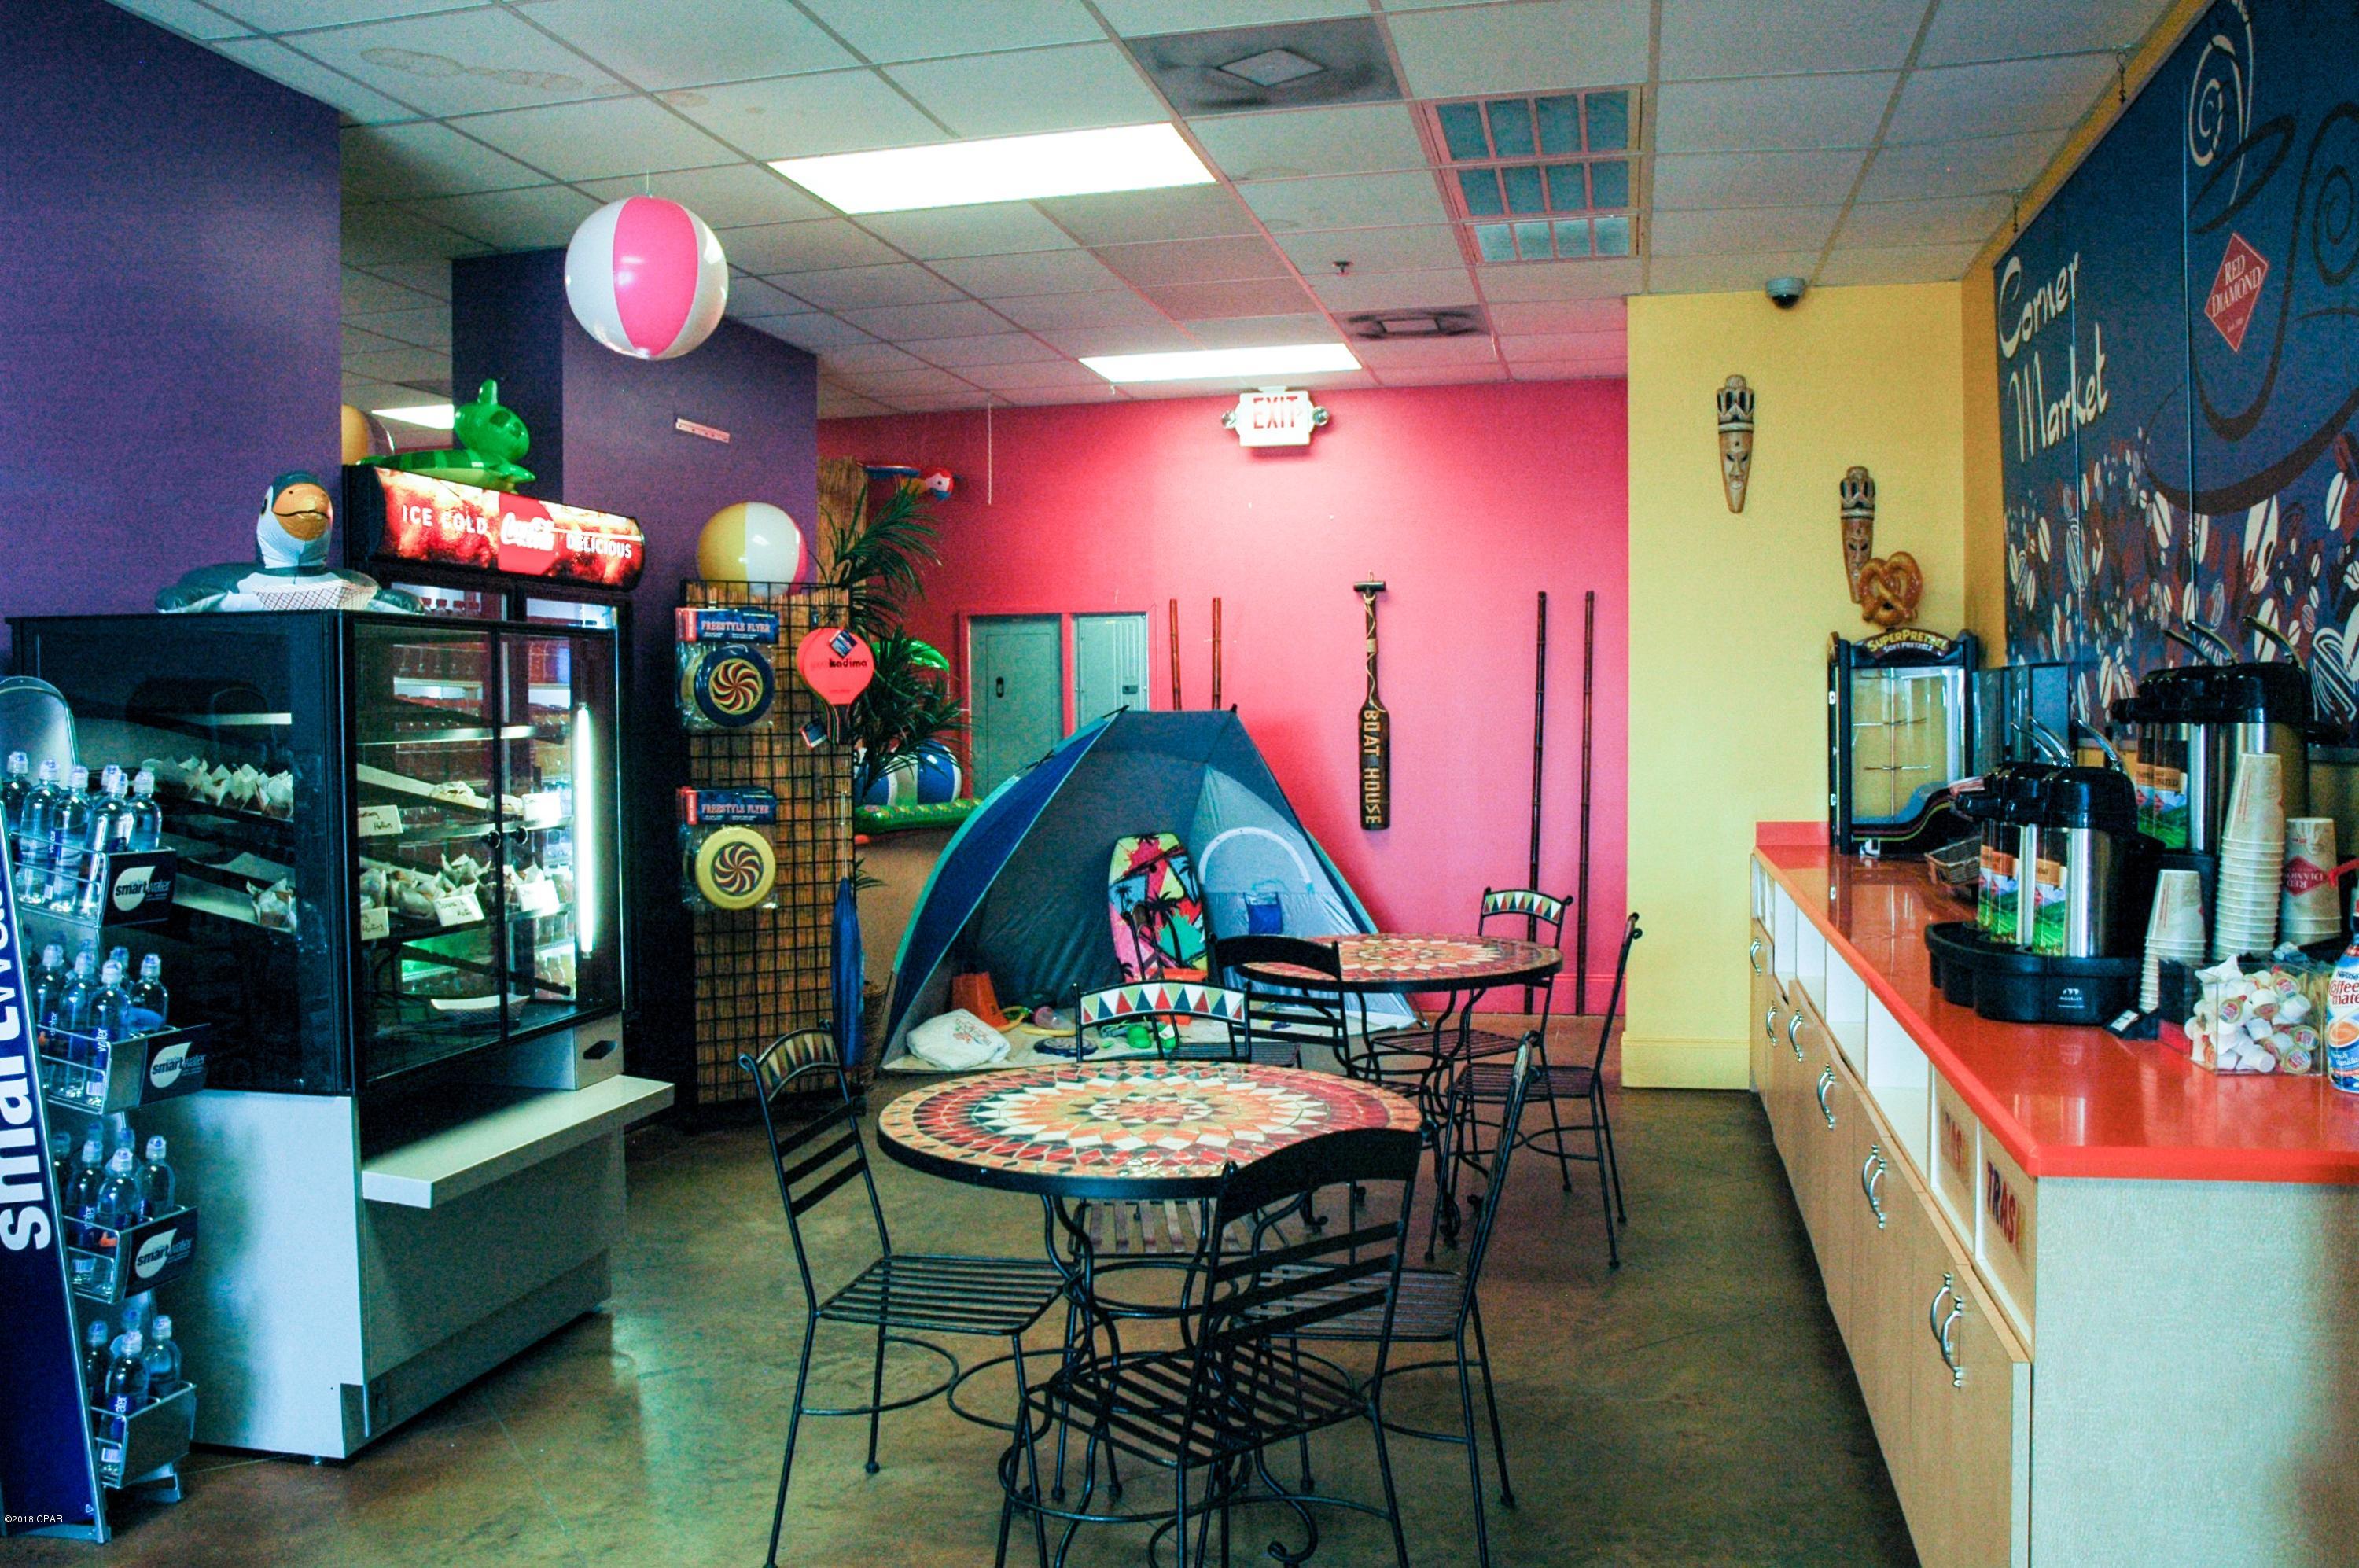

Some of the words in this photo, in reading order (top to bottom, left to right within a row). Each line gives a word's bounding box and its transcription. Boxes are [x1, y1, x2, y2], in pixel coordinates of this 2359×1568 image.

[2210, 266, 2261, 318] DIAMOND
[2225, 254, 2246, 287] RED
[1999, 252, 2079, 359] Corner
[1253, 396, 1298, 429] EXIT
[2007, 321, 2109, 463] Market
[402, 505, 432, 528] ICE
[441, 510, 488, 535] COLD
[566, 532, 632, 559] DELICIOUS
[701, 620, 745, 631] FREESTYLE
[747, 623, 770, 633] FLYER
[829, 658, 868, 668] kadima
[1363, 709, 1382, 757] BOAT
[1364, 767, 1382, 824] HOUSE
